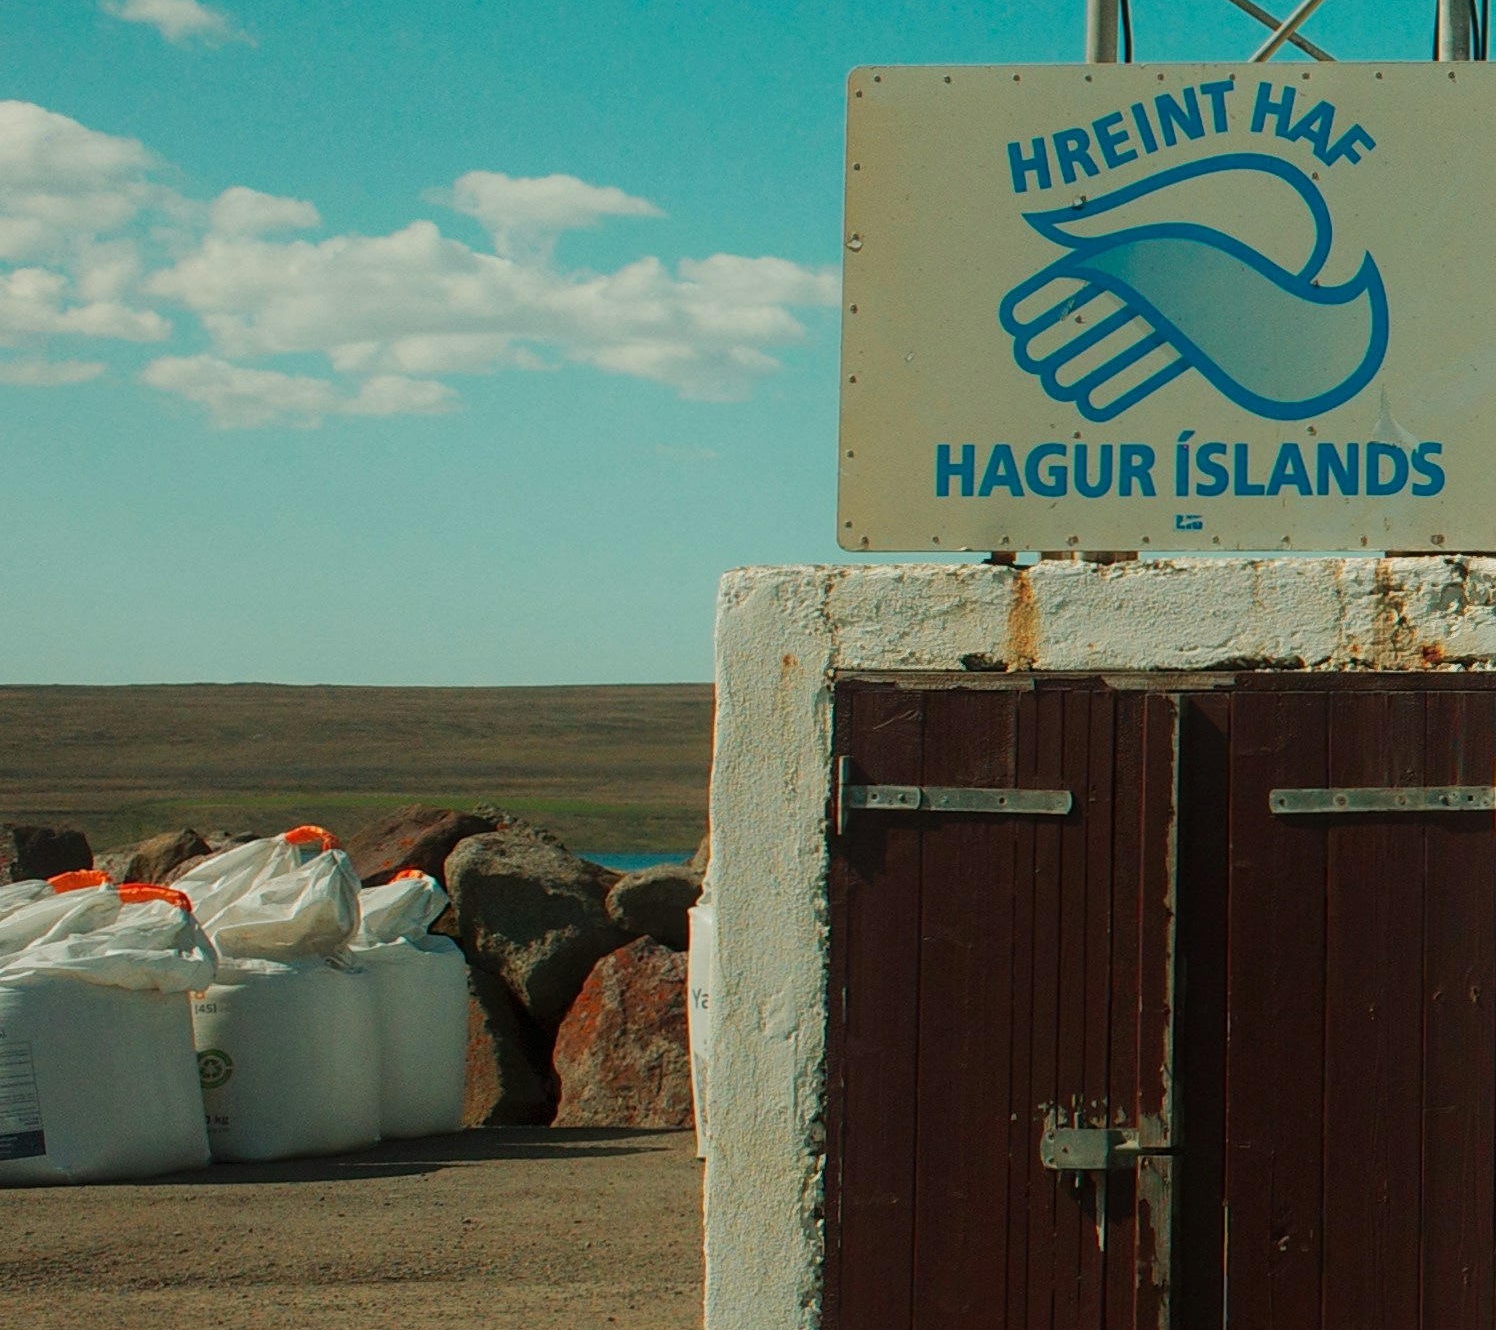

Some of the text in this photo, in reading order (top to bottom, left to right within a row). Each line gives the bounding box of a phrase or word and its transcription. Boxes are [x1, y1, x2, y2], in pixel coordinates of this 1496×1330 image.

[1007, 78, 1376, 194] HREINT HAF
[935, 431, 1446, 499] HAGUR ÍSLANDS
